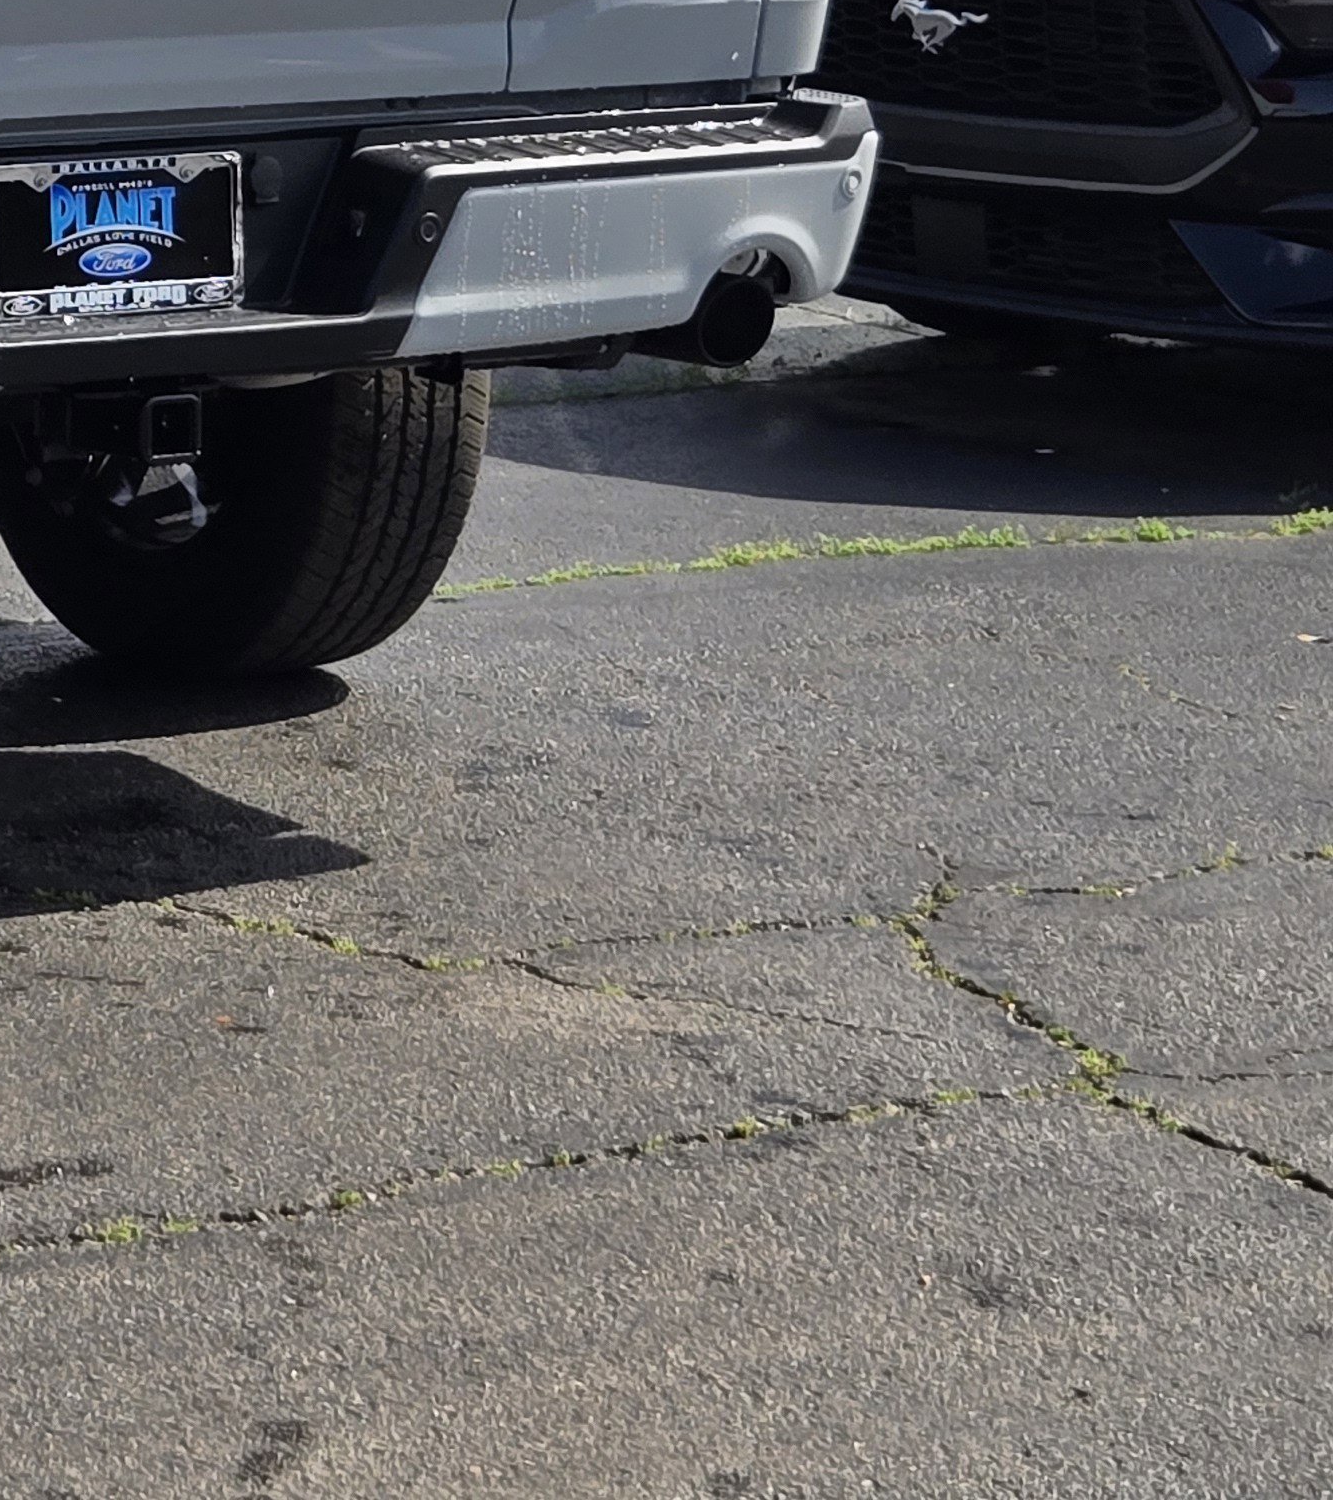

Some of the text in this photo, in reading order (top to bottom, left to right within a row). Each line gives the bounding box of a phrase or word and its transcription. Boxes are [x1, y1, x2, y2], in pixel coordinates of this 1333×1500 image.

[50, 183, 177, 245] PLANET
[139, 233, 173, 248] FIELD
[93, 250, 137, 271] Ford
[50, 288, 128, 313] PLANET
